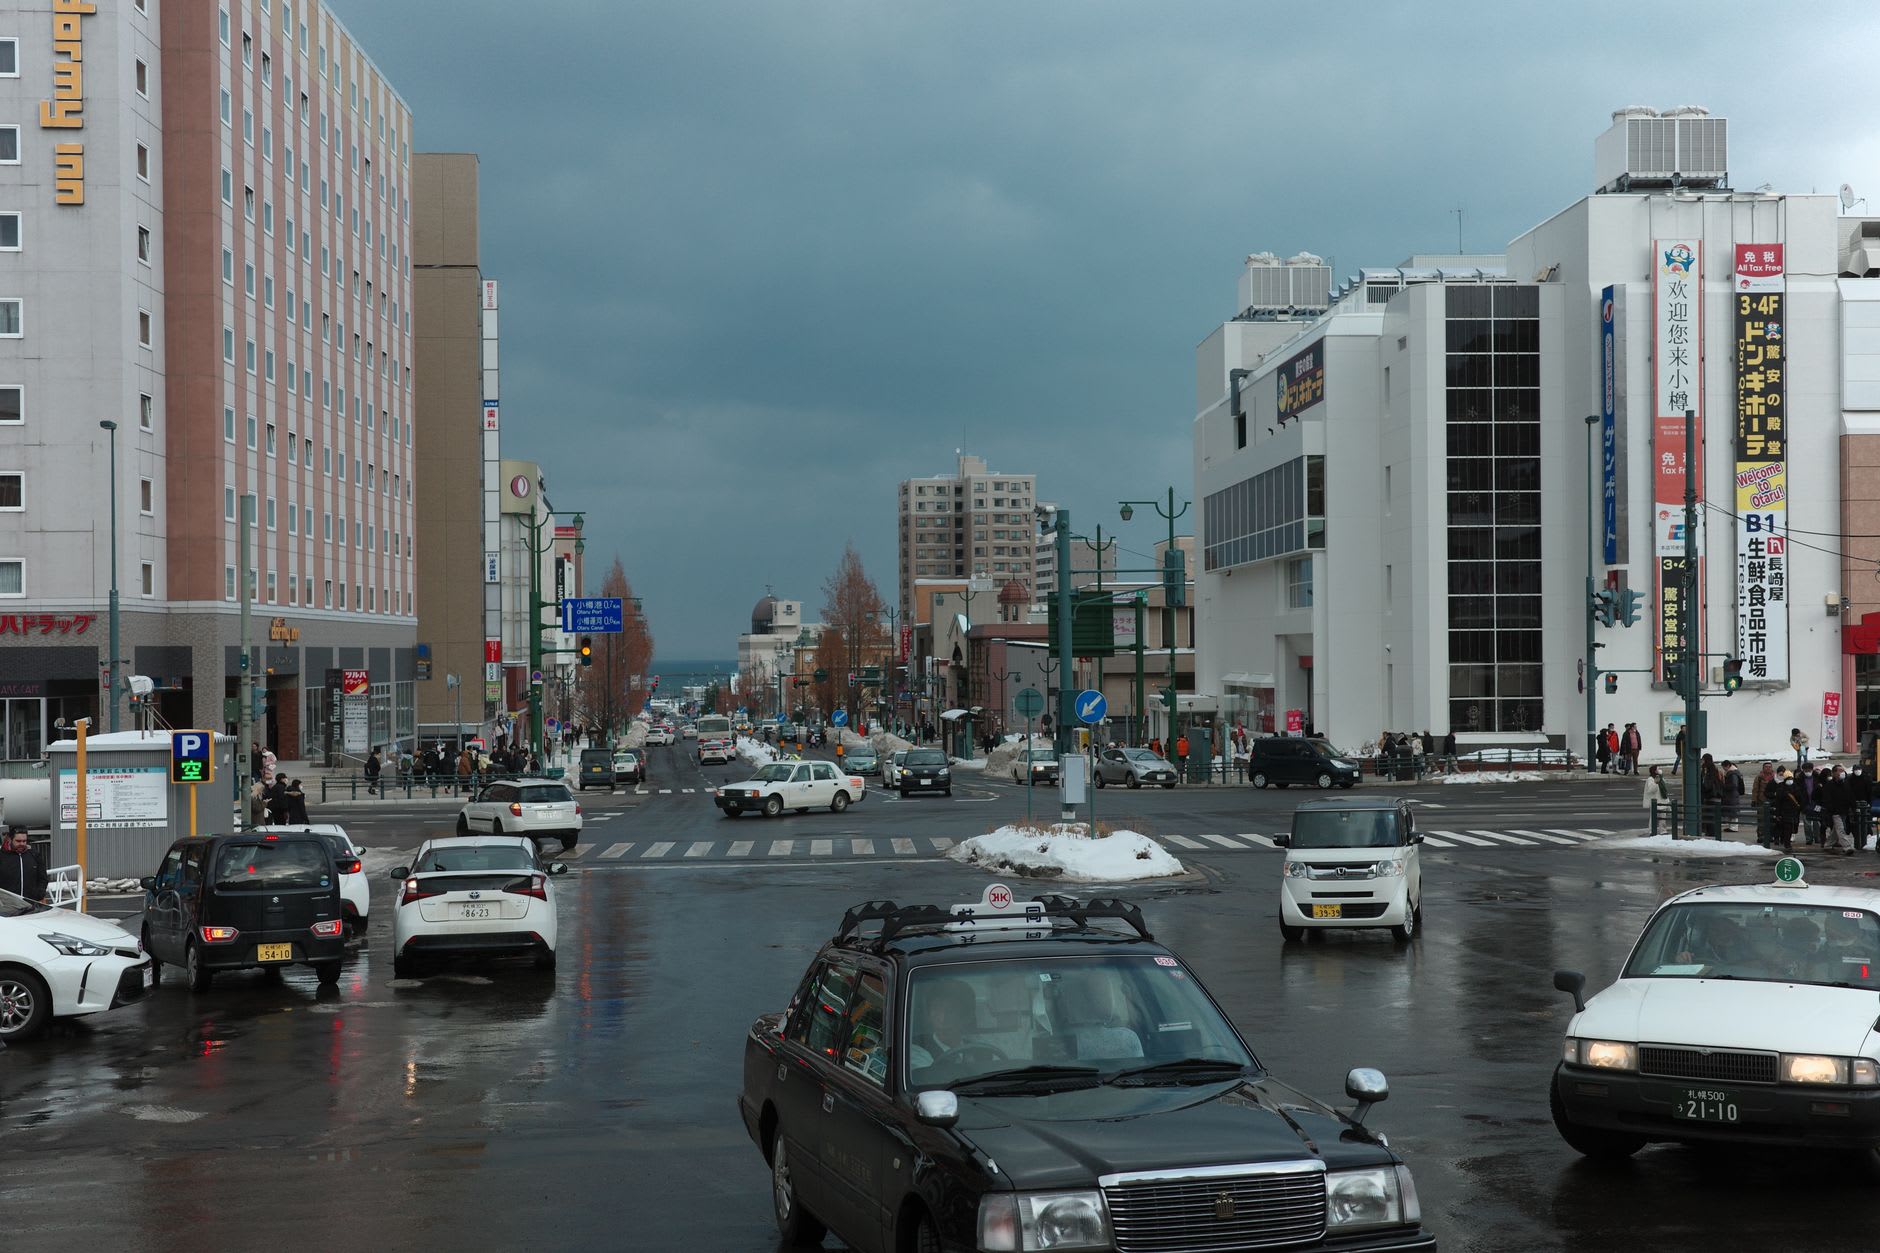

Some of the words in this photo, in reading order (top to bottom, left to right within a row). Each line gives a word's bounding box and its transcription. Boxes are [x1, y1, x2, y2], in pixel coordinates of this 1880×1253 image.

[55, 143, 84, 204] inn
[1744, 251, 1775, 263] 免税
[1738, 264, 1748, 272] All
[1749, 264, 1763, 272] Tax
[1765, 264, 1782, 272] Free
[1667, 280, 1689, 412] 欢迎您来小樽
[1766, 345, 1781, 455] 驚安の殿堂
[1661, 466, 1677, 475] Tax
[1737, 463, 1782, 486] Welcome
[1605, 425, 1616, 547] サンポート
[1758, 481, 1769, 492] to
[1752, 487, 1784, 507] Otaru!
[1747, 514, 1774, 532] B1
[1739, 553, 1747, 607] Fresh
[577, 601, 602, 610] 小樽港
[1748, 537, 1767, 677] 生鮮食品市場
[1739, 614, 1747, 662] Food
[330, 688, 343, 722] dormy
[182, 735, 201, 757] P
[182, 760, 202, 780] 空
[465, 908, 489, 918] 86-23
[265, 949, 290, 960] 54-10
[1688, 1090, 1725, 1101] 札幌500
[1687, 1100, 1737, 1120] 21-10
